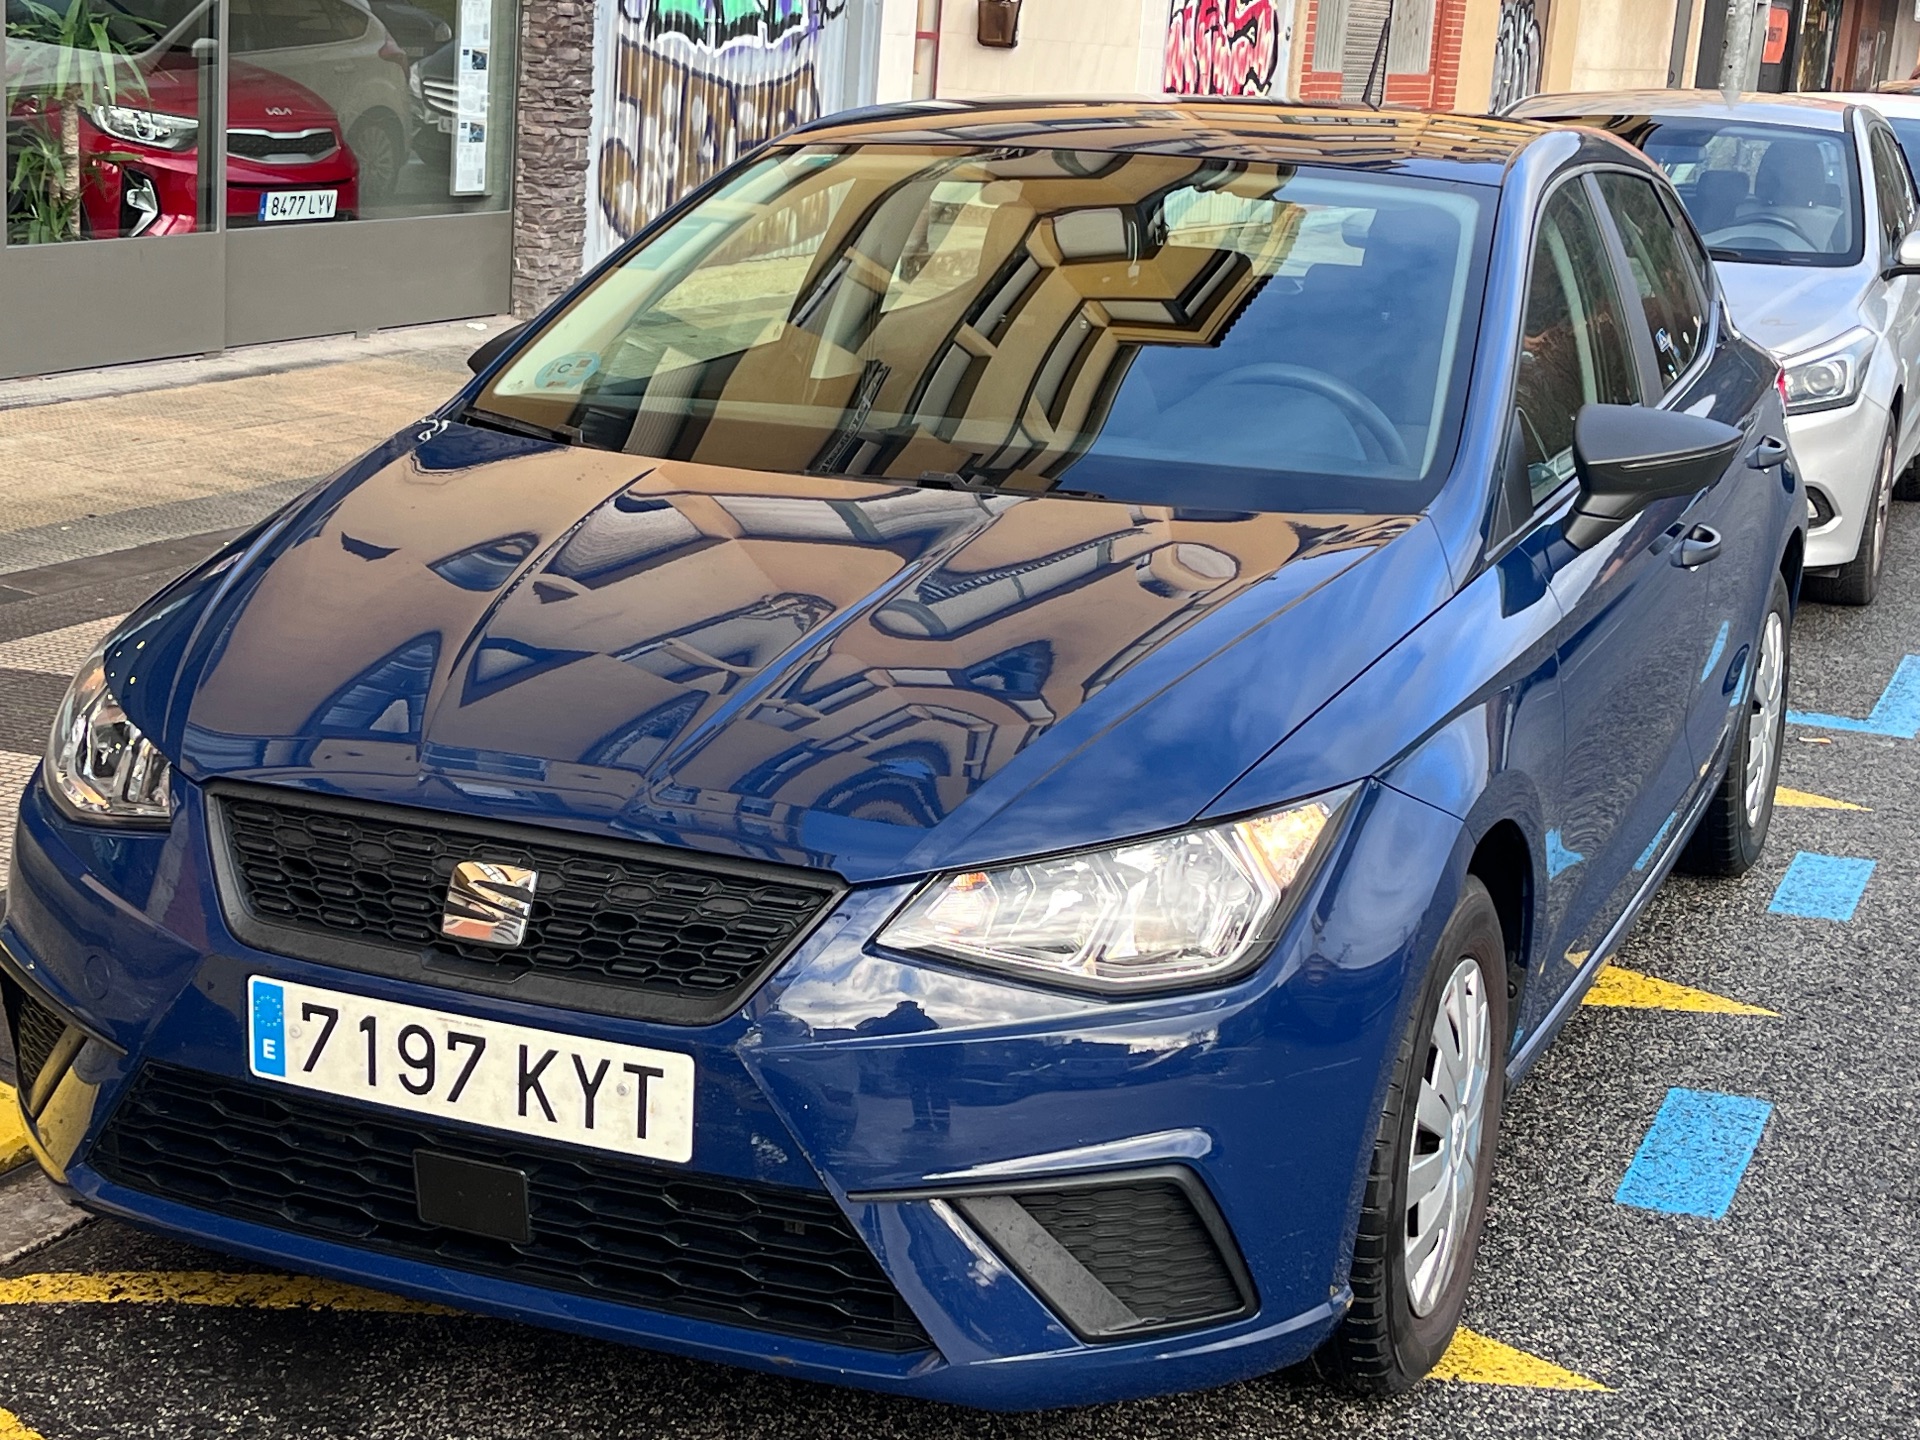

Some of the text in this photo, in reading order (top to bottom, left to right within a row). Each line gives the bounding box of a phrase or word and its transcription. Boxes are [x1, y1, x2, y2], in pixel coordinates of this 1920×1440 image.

[271, 194, 333, 216] 8477 LYV
[262, 1038, 276, 1060] E
[301, 1002, 664, 1140] 7197 KYT
